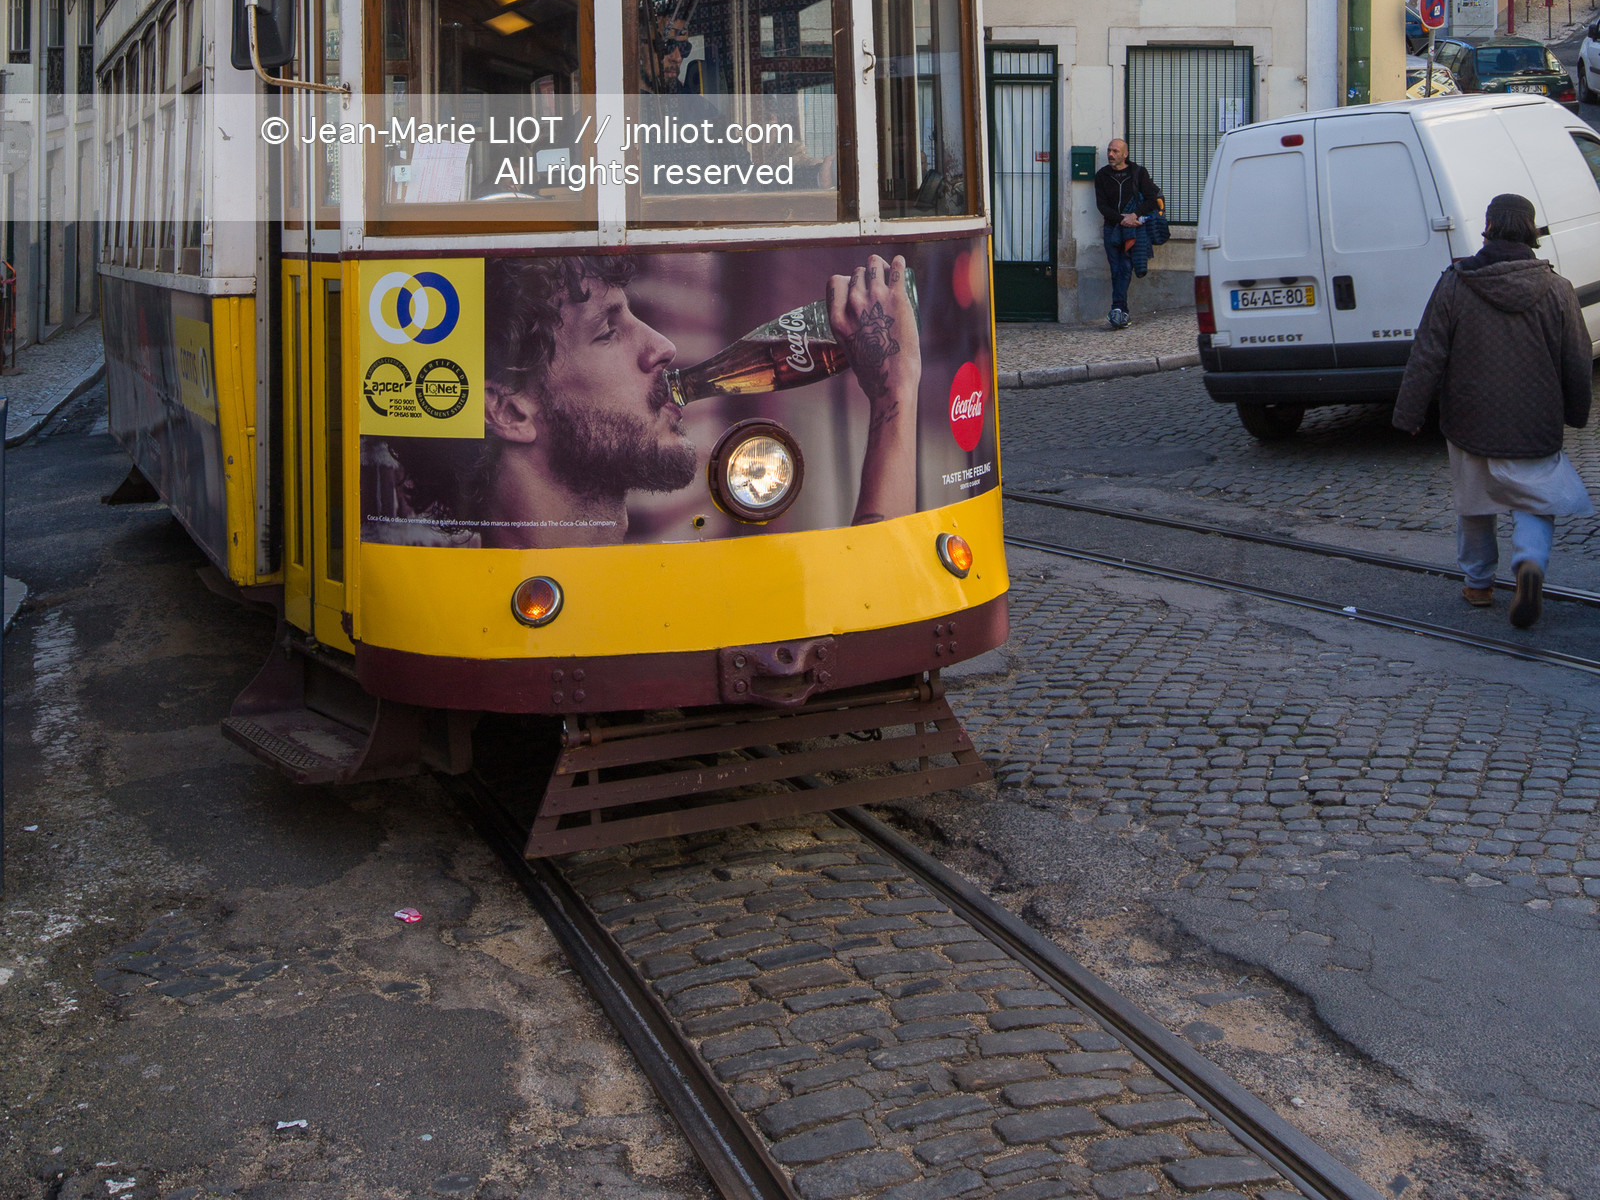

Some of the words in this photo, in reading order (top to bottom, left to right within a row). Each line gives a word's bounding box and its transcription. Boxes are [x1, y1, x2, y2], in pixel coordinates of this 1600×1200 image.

[1240, 333, 1304, 344] PEUGEOT
[419, 359, 465, 380] CERTIFIED
[372, 381, 404, 396] apcer
[416, 392, 450, 418] MANAGEMENT
[450, 392, 467, 414] SYSTEM
[942, 471, 962, 485] TASTE
[962, 468, 974, 481] THE
[973, 461, 991, 477] FEELING
[394, 516, 408, 524] disco
[408, 517, 432, 525] vermelho
[480, 519, 490, 527] são
[511, 520, 540, 528] registadas
[559, 519, 588, 527] Coca-Cola
[588, 519, 618, 528] Company.
